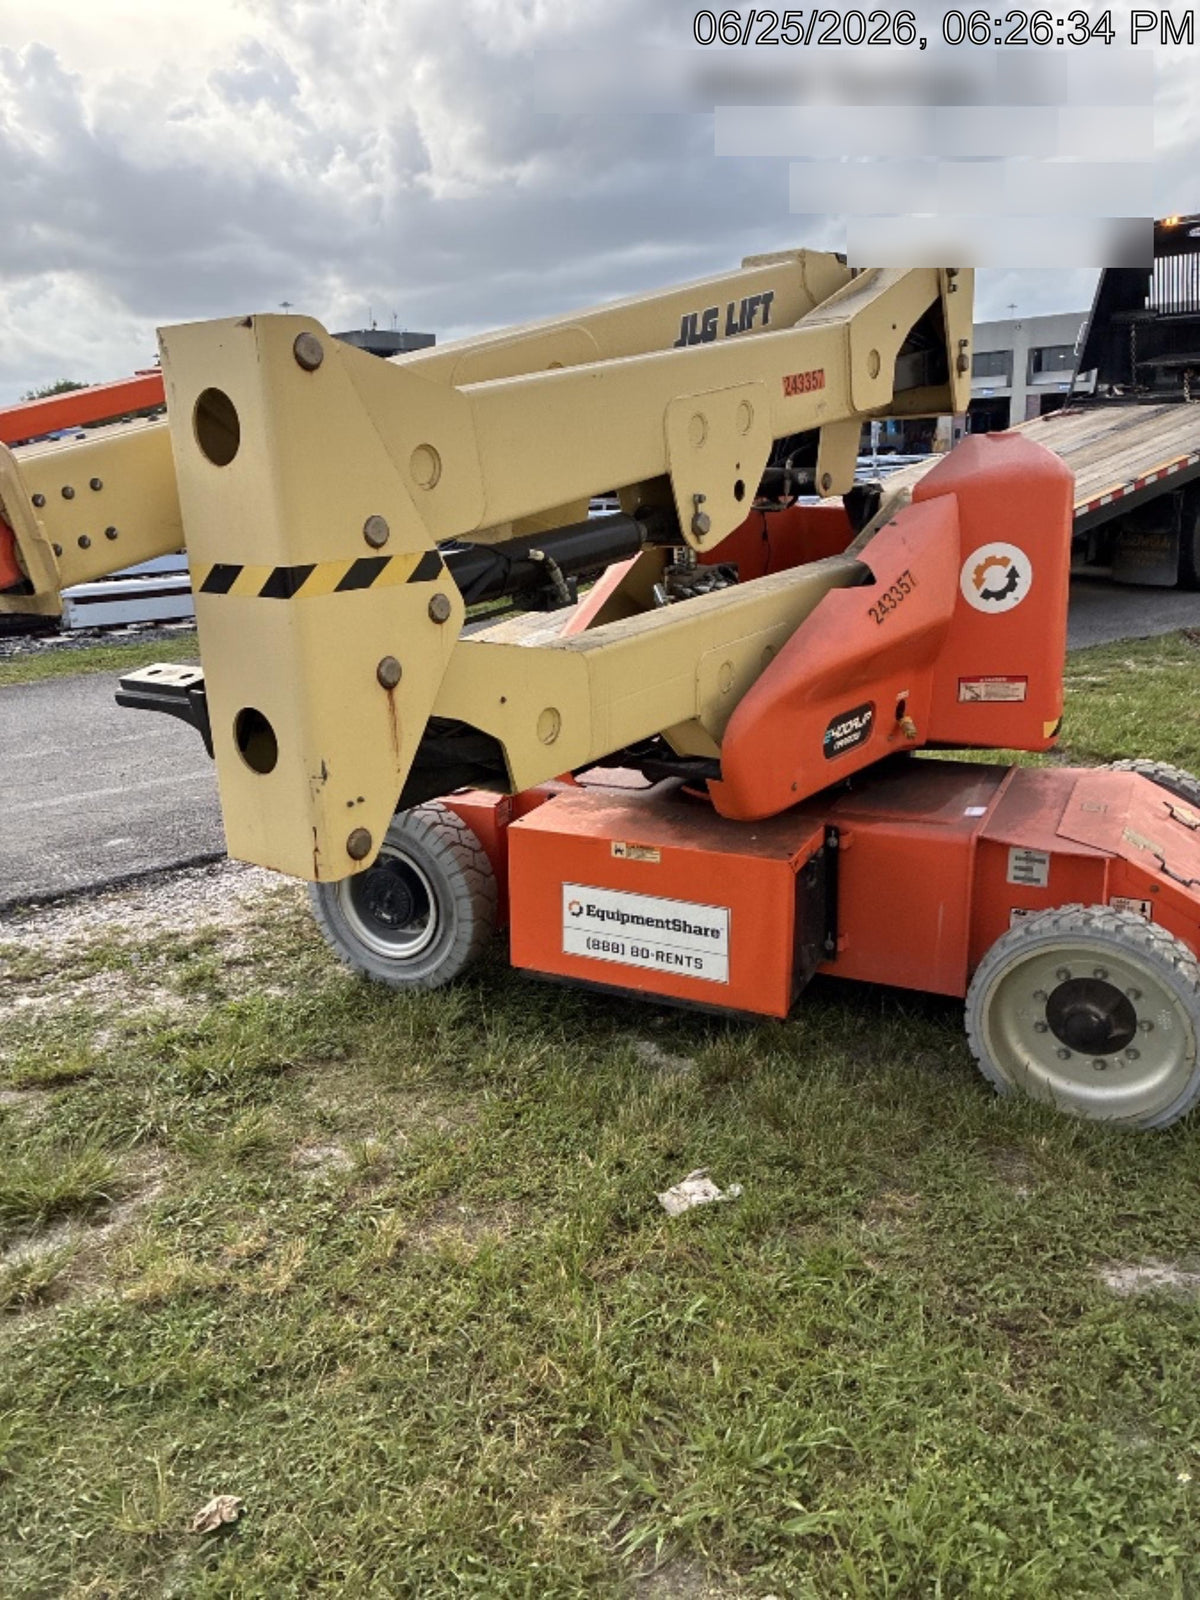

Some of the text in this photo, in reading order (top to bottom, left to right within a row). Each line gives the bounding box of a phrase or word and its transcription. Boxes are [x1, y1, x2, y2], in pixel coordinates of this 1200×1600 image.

[673, 289, 775, 348] JLG LIFT
[783, 368, 825, 397] 243357
[868, 569, 918, 625] 243357
[586, 903, 721, 940] EquipmentShare
[586, 936, 704, 970] (888) 80-RENTS
